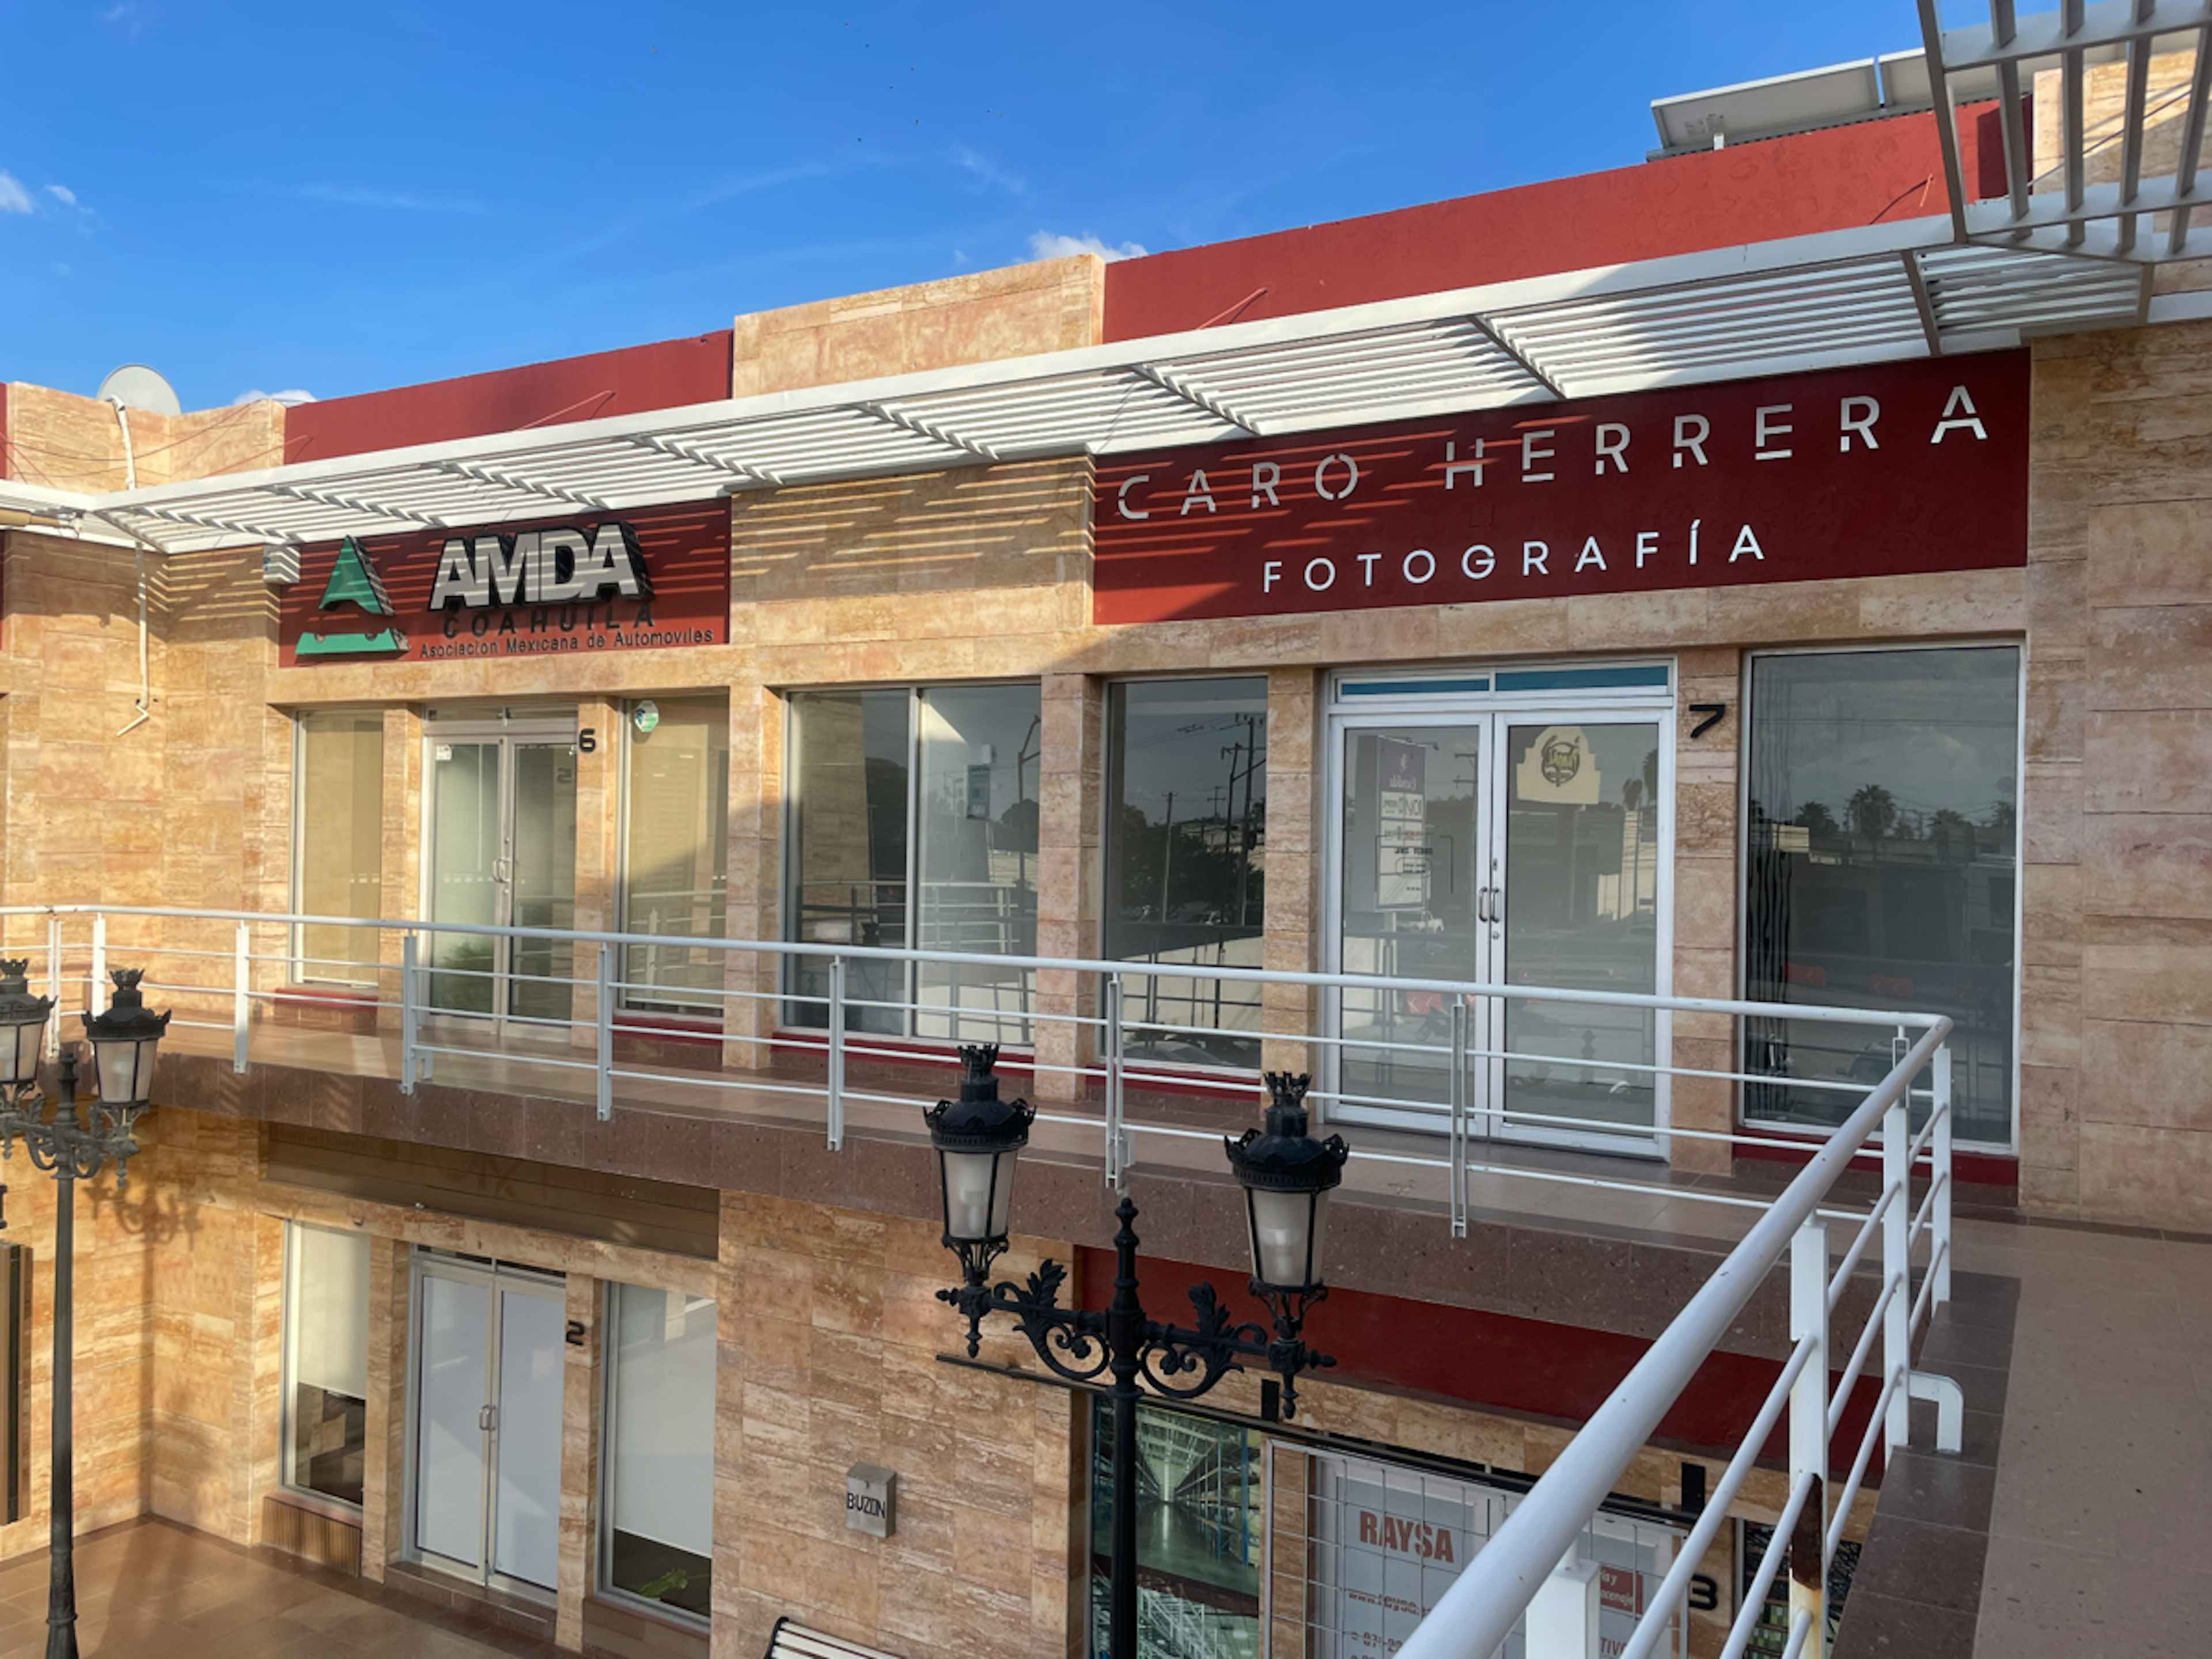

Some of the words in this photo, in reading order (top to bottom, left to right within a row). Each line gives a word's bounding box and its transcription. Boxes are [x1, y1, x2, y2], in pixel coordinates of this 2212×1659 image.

[1118, 453, 1358, 519] CARO
[1445, 385, 1987, 490] HERRERA
[429, 521, 644, 611] AMDA
[1263, 520, 1764, 592] FOTOGRAFÍA
[443, 603, 654, 639] COAHUILA
[506, 636, 578, 653] Mexicana
[587, 633, 605, 647] de
[1688, 704, 1725, 739] 7
[579, 728, 596, 753] 6
[566, 1320, 585, 1346] 2
[1359, 1510, 1455, 1563] RAYSA
[1688, 1574, 1718, 1611] 3
